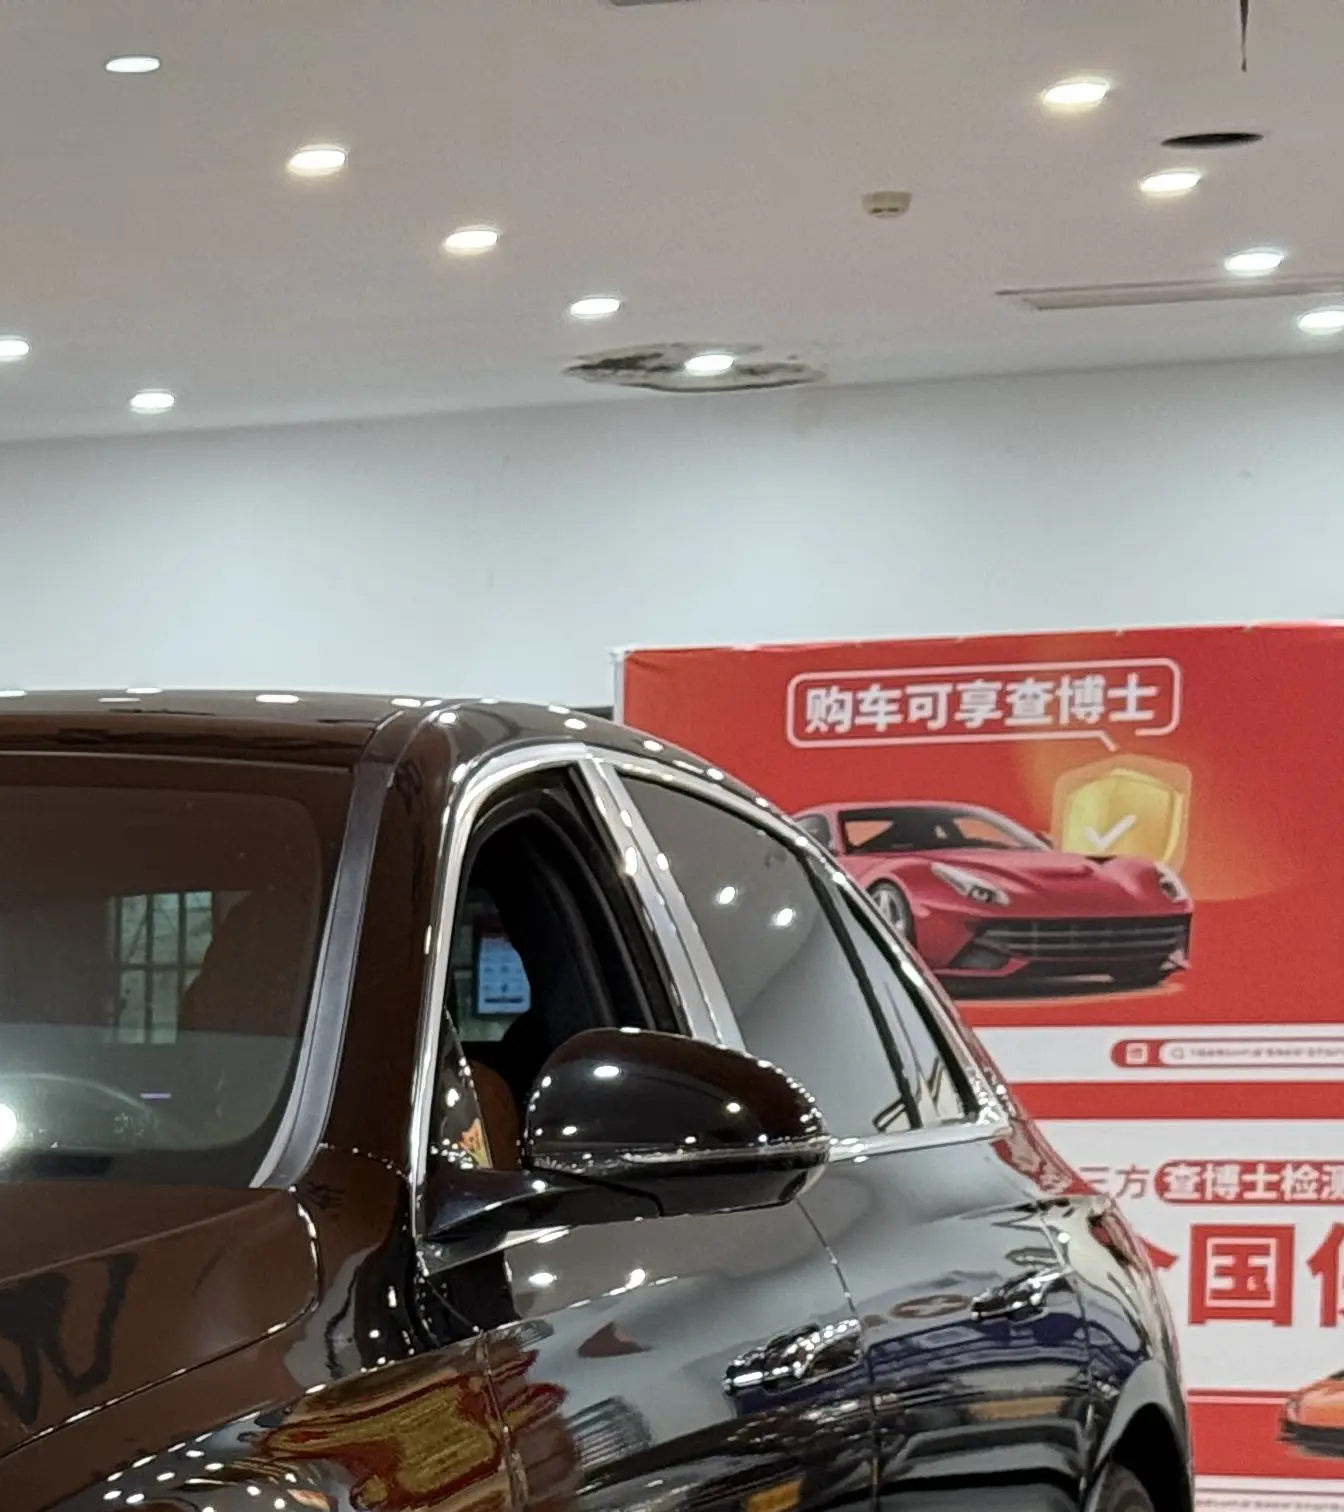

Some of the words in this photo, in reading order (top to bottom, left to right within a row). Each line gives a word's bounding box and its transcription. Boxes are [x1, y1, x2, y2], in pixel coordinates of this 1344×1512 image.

[804, 672, 1158, 735] 购车可享查博士
